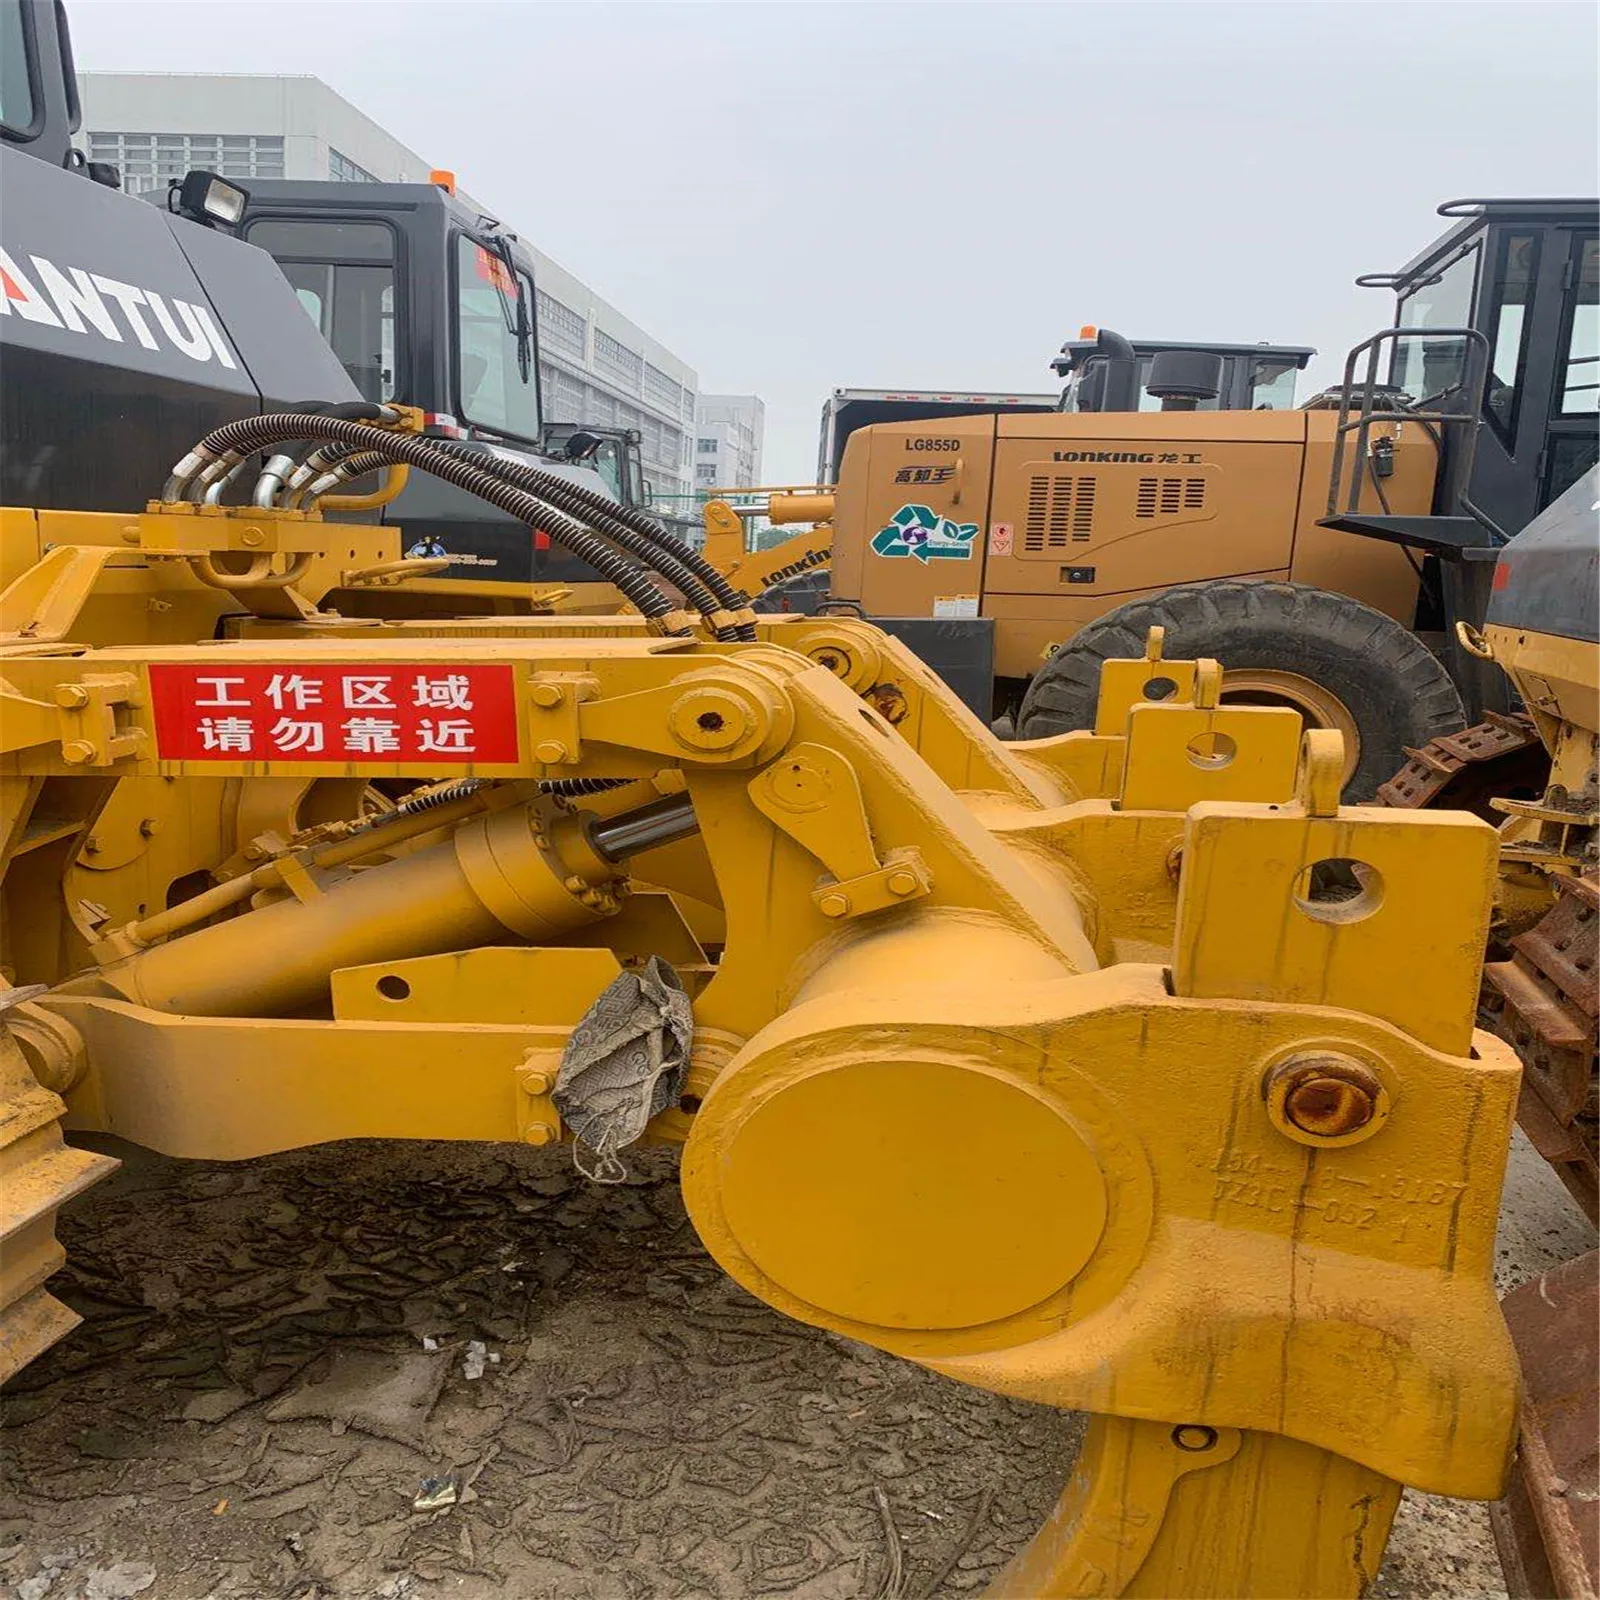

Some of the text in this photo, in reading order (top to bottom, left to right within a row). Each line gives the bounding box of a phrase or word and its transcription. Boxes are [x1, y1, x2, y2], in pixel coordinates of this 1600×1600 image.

[905, 439, 960, 451] LG855D
[1157, 453, 1202, 464] 龙工
[195, 674, 473, 710] 工作区域
[197, 717, 476, 753] 请勿靠近
